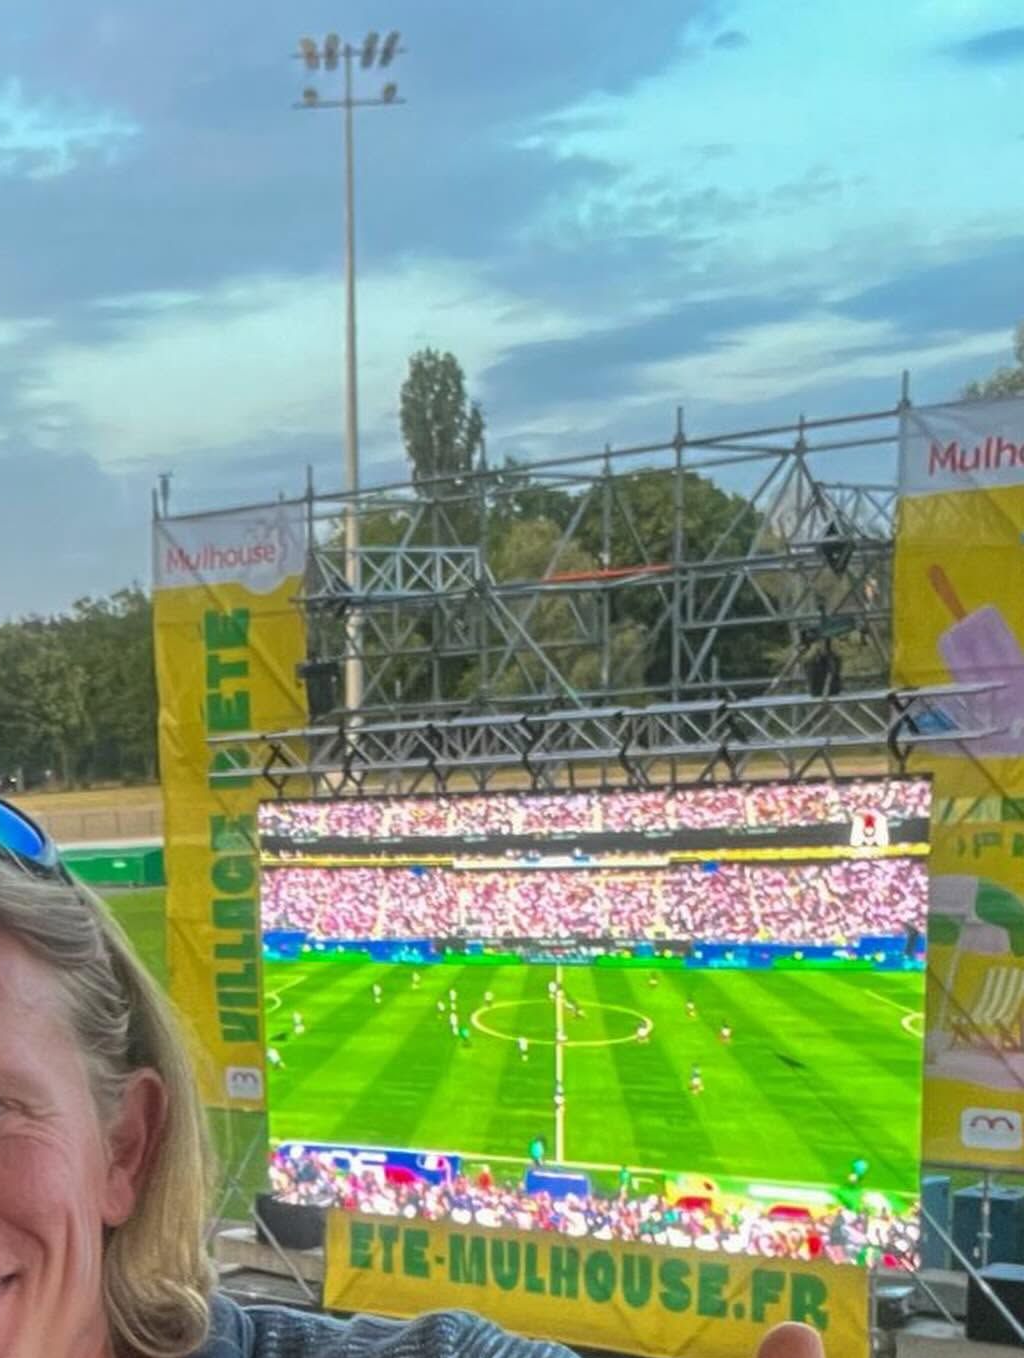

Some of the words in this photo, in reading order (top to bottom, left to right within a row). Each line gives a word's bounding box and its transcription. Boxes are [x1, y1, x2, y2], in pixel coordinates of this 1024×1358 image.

[929, 436, 1024, 477] Mulh
[165, 542, 275, 574] Mulhouse
[209, 814, 258, 1041] VILLAGE
